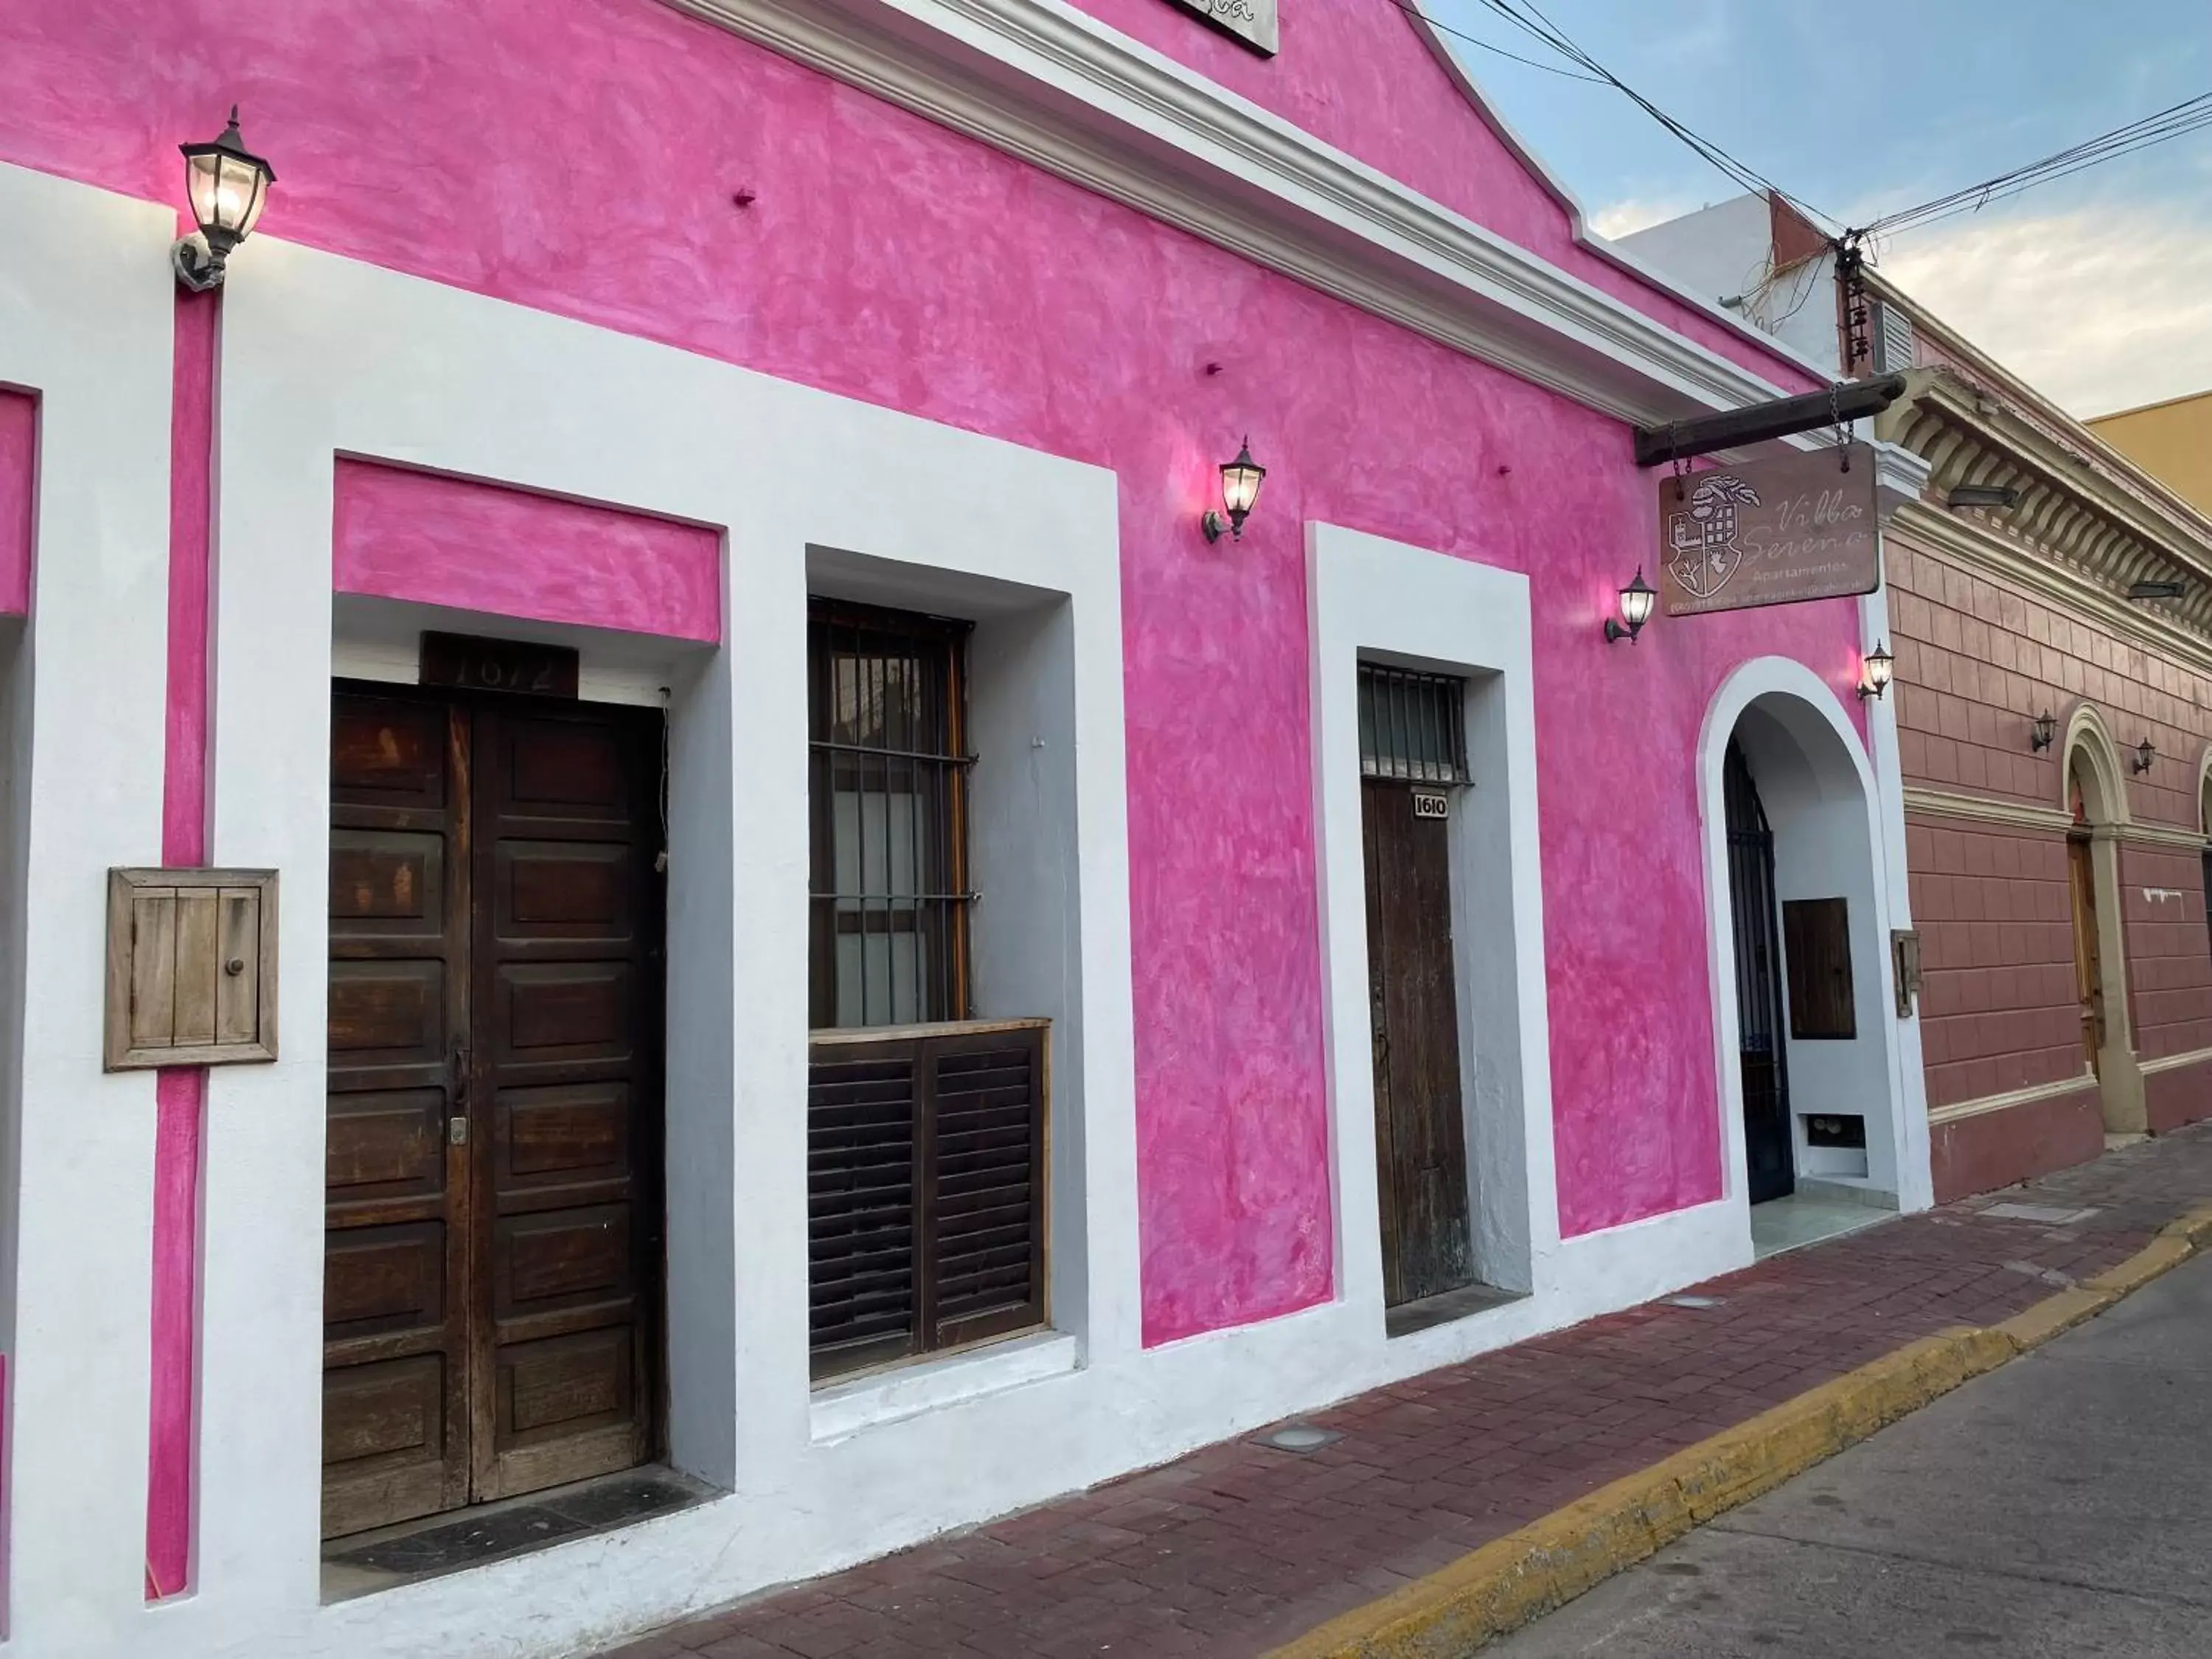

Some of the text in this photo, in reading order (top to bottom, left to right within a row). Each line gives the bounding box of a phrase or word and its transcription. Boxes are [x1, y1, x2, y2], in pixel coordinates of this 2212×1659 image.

[1775, 488, 1863, 531] Villa
[1743, 526, 1868, 566] Serena
[1417, 797, 1446, 815] 1610
